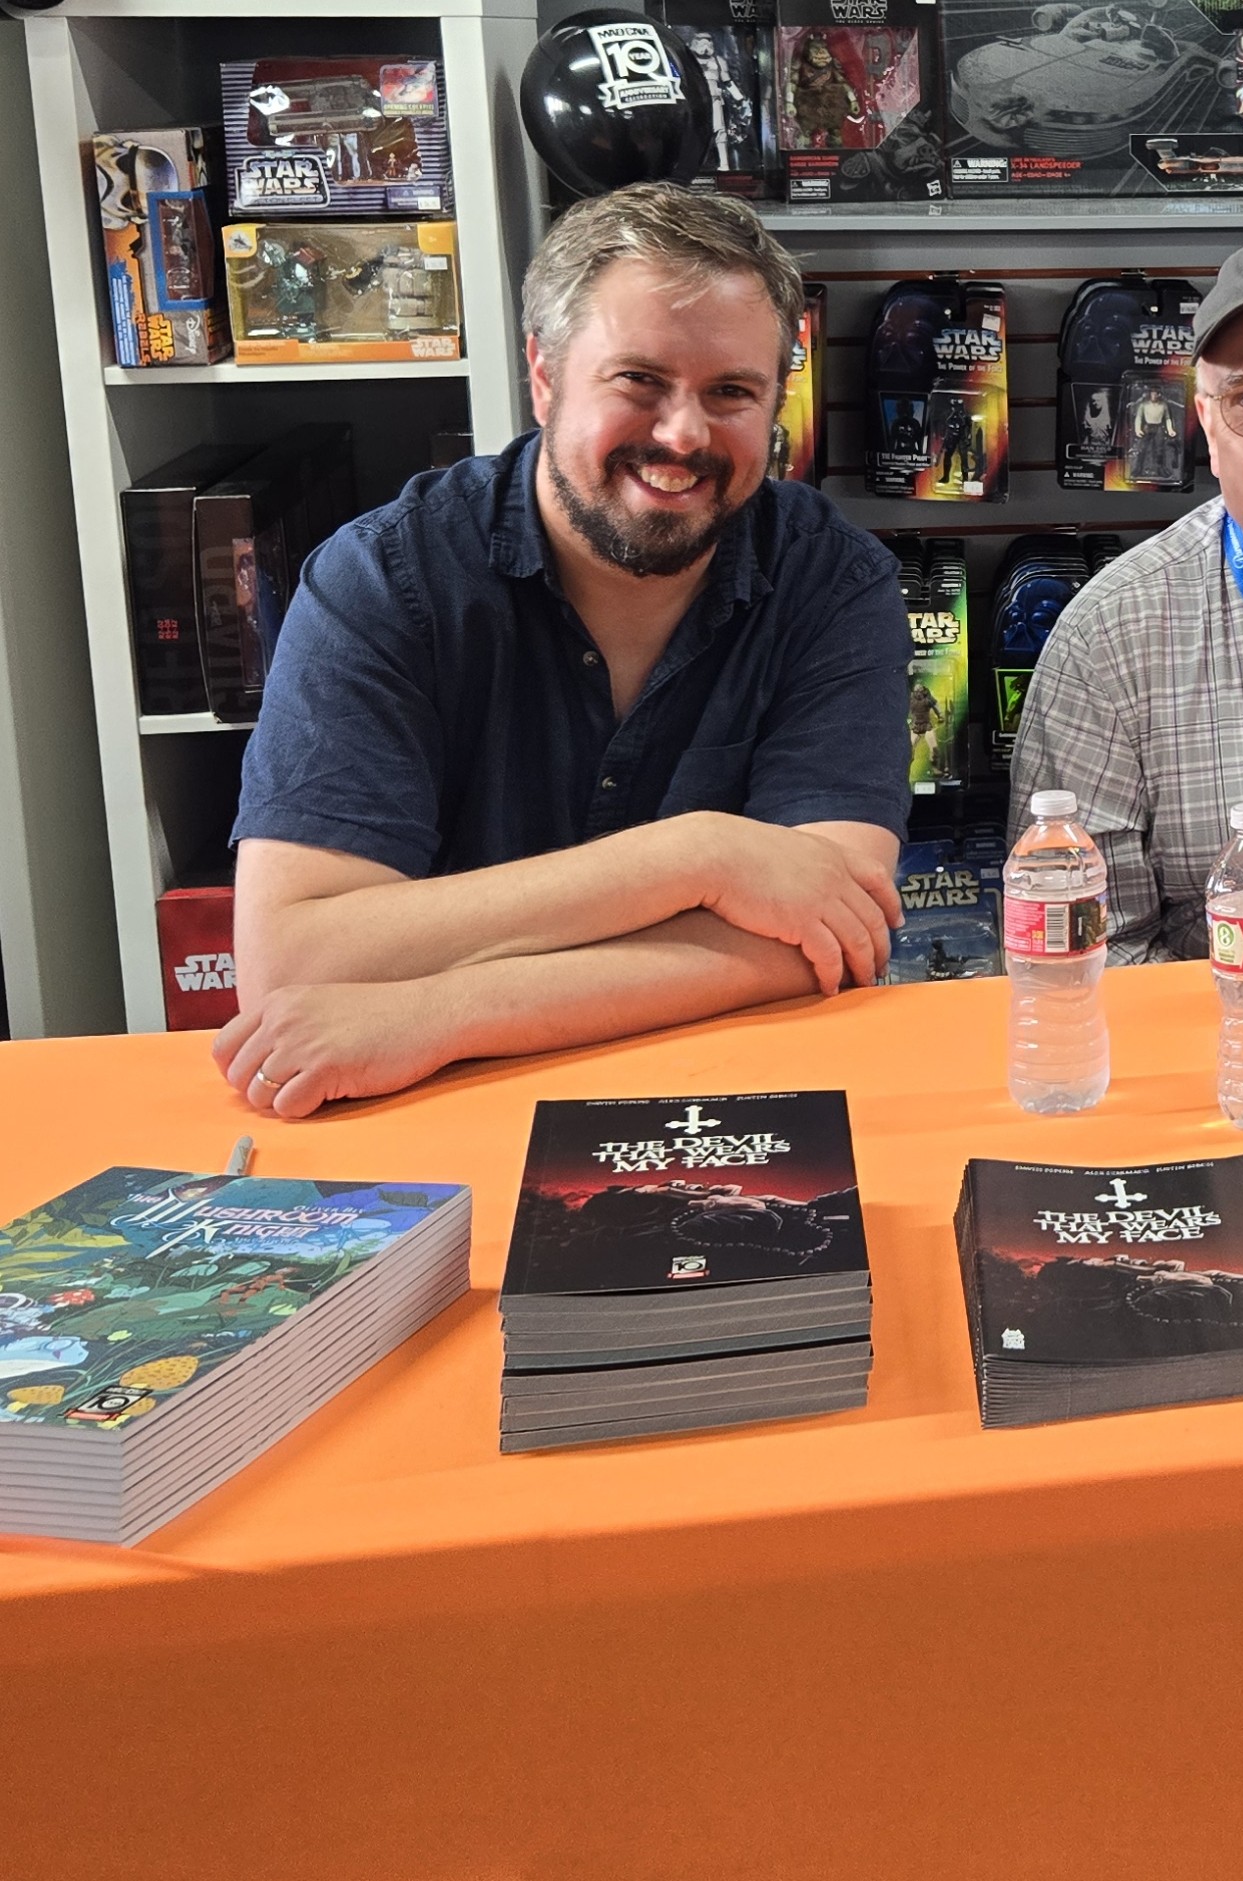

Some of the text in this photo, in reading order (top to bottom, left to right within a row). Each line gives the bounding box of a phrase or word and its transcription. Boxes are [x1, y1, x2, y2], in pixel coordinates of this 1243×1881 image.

[832, 4, 888, 19] WARS
[597, 28, 624, 38] MAD
[606, 40, 660, 77] 10
[244, 160, 319, 178] STAR
[240, 178, 320, 194] WARS
[136, 311, 151, 366] REBELS
[147, 313, 162, 361] WARS
[160, 318, 175, 360] STAR
[932, 328, 1001, 346] STAR
[1131, 325, 1195, 341] STAR
[409, 338, 454, 348] STAR
[411, 347, 455, 357] WARS
[1131, 339, 1195, 355] WARS
[933, 344, 1002, 361] WARS
[907, 612, 959, 628] TAR
[911, 628, 960, 644] ARS
[901, 870, 979, 891] STAR
[901, 888, 980, 910] WARS
[174, 953, 236, 973] STA
[175, 971, 236, 991] WAR
[592, 1142, 791, 1162] THAT WEARS
[599, 1133, 786, 1153] THE DEVIL
[612, 1152, 770, 1173] MY FACE
[128, 1188, 361, 1225] MUSHROOM
[1038, 1205, 1214, 1223] THE DEVIL
[1033, 1213, 1222, 1232] THAT WEARS
[145, 1219, 321, 1259] KNIGHT
[1056, 1226, 1204, 1244] MY FACE
[86, 1395, 130, 1410] 10
